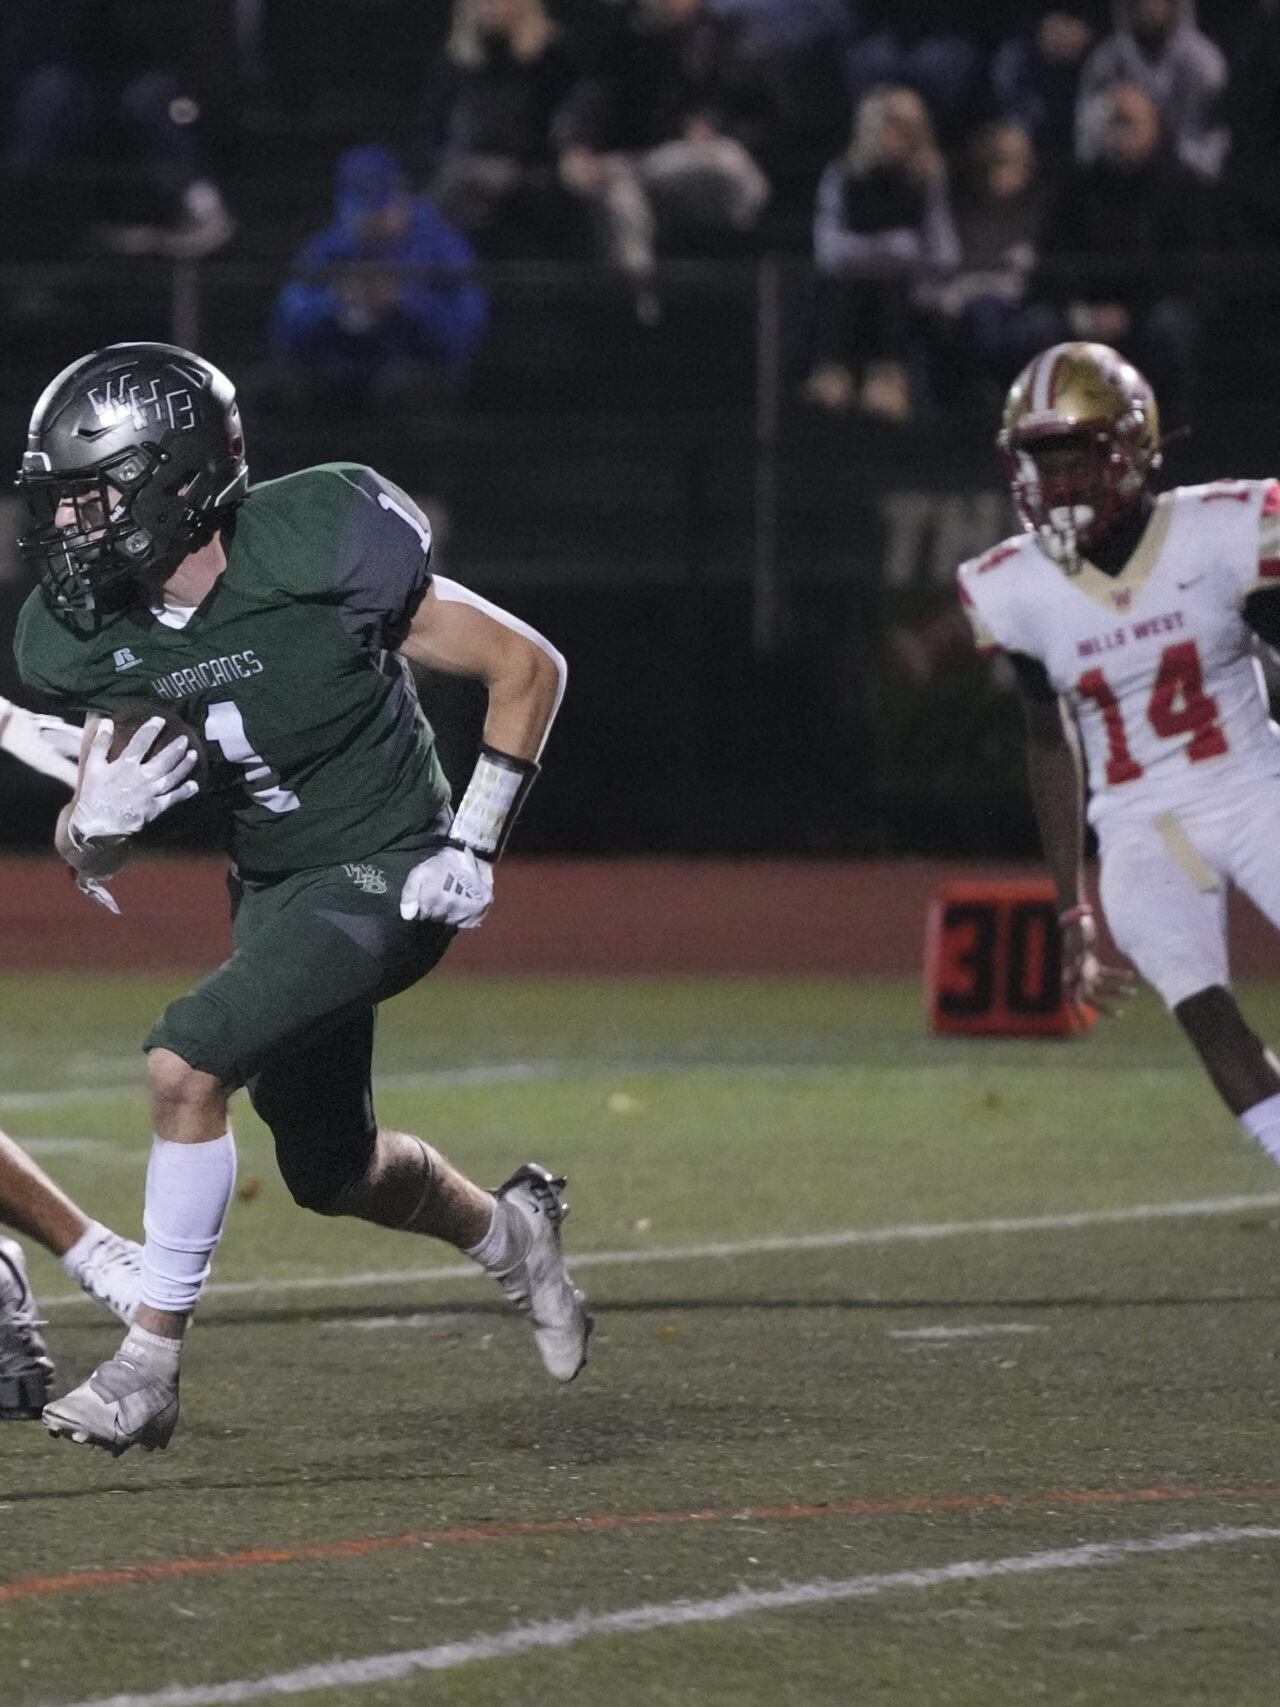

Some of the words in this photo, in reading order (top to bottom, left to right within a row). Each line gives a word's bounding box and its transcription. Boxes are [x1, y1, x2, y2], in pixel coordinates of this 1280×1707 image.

[150, 649, 265, 700] HURRICANES
[1132, 610, 1184, 640] WEST
[203, 700, 302, 814] 1
[1075, 638, 1231, 786] 14
[938, 899, 1063, 1018] 30
